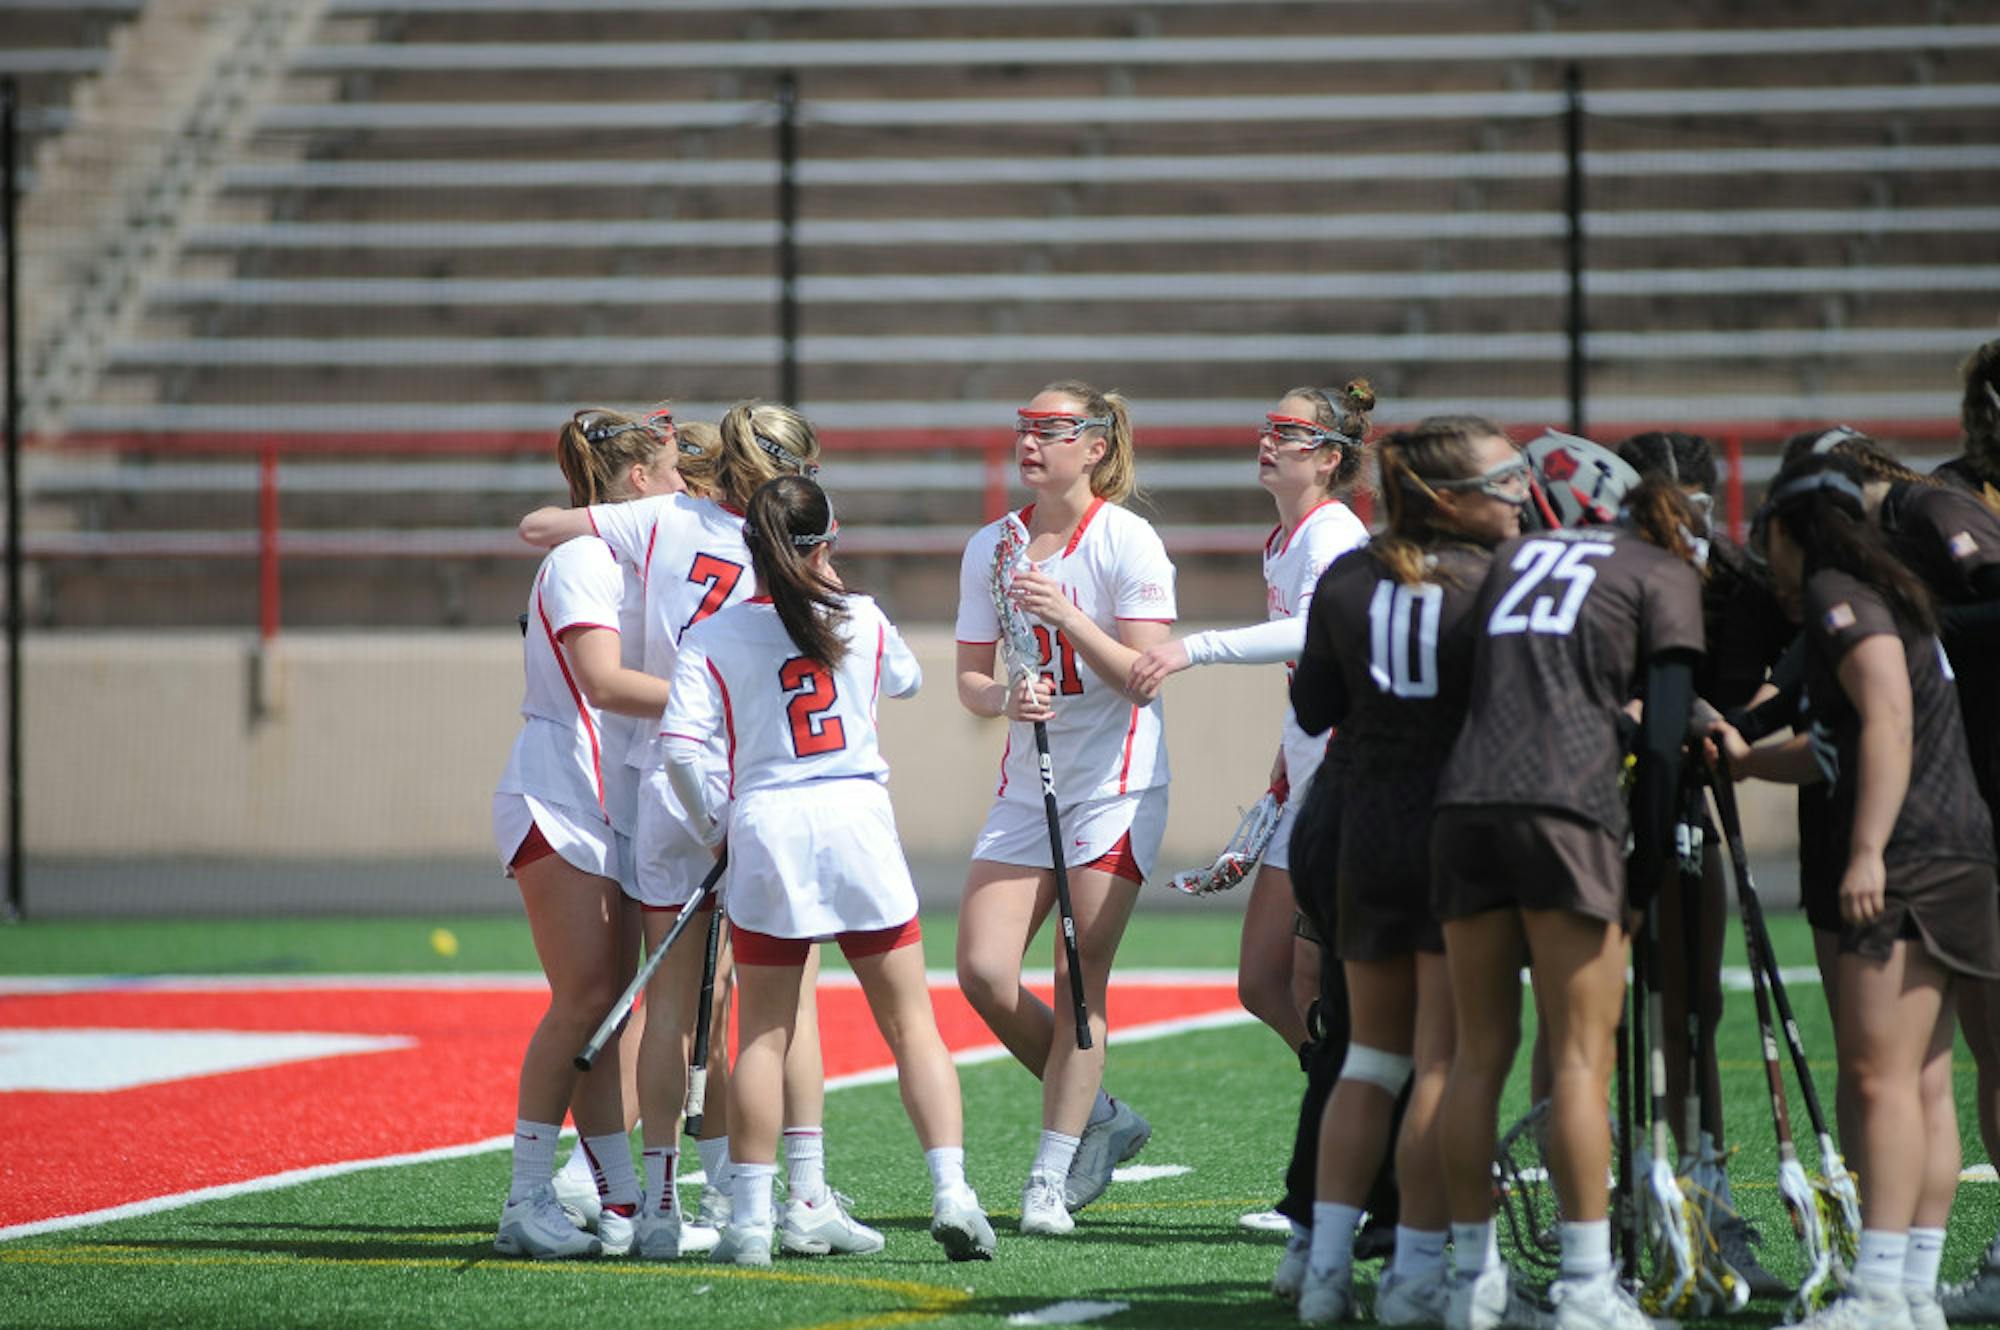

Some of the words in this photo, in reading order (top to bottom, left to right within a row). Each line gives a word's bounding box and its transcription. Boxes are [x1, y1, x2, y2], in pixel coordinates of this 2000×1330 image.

[677, 552, 745, 646] 7
[1487, 539, 1616, 636] 25
[1031, 624, 1084, 697] 21
[1367, 579, 1444, 698] 10
[778, 656, 846, 759] 2
